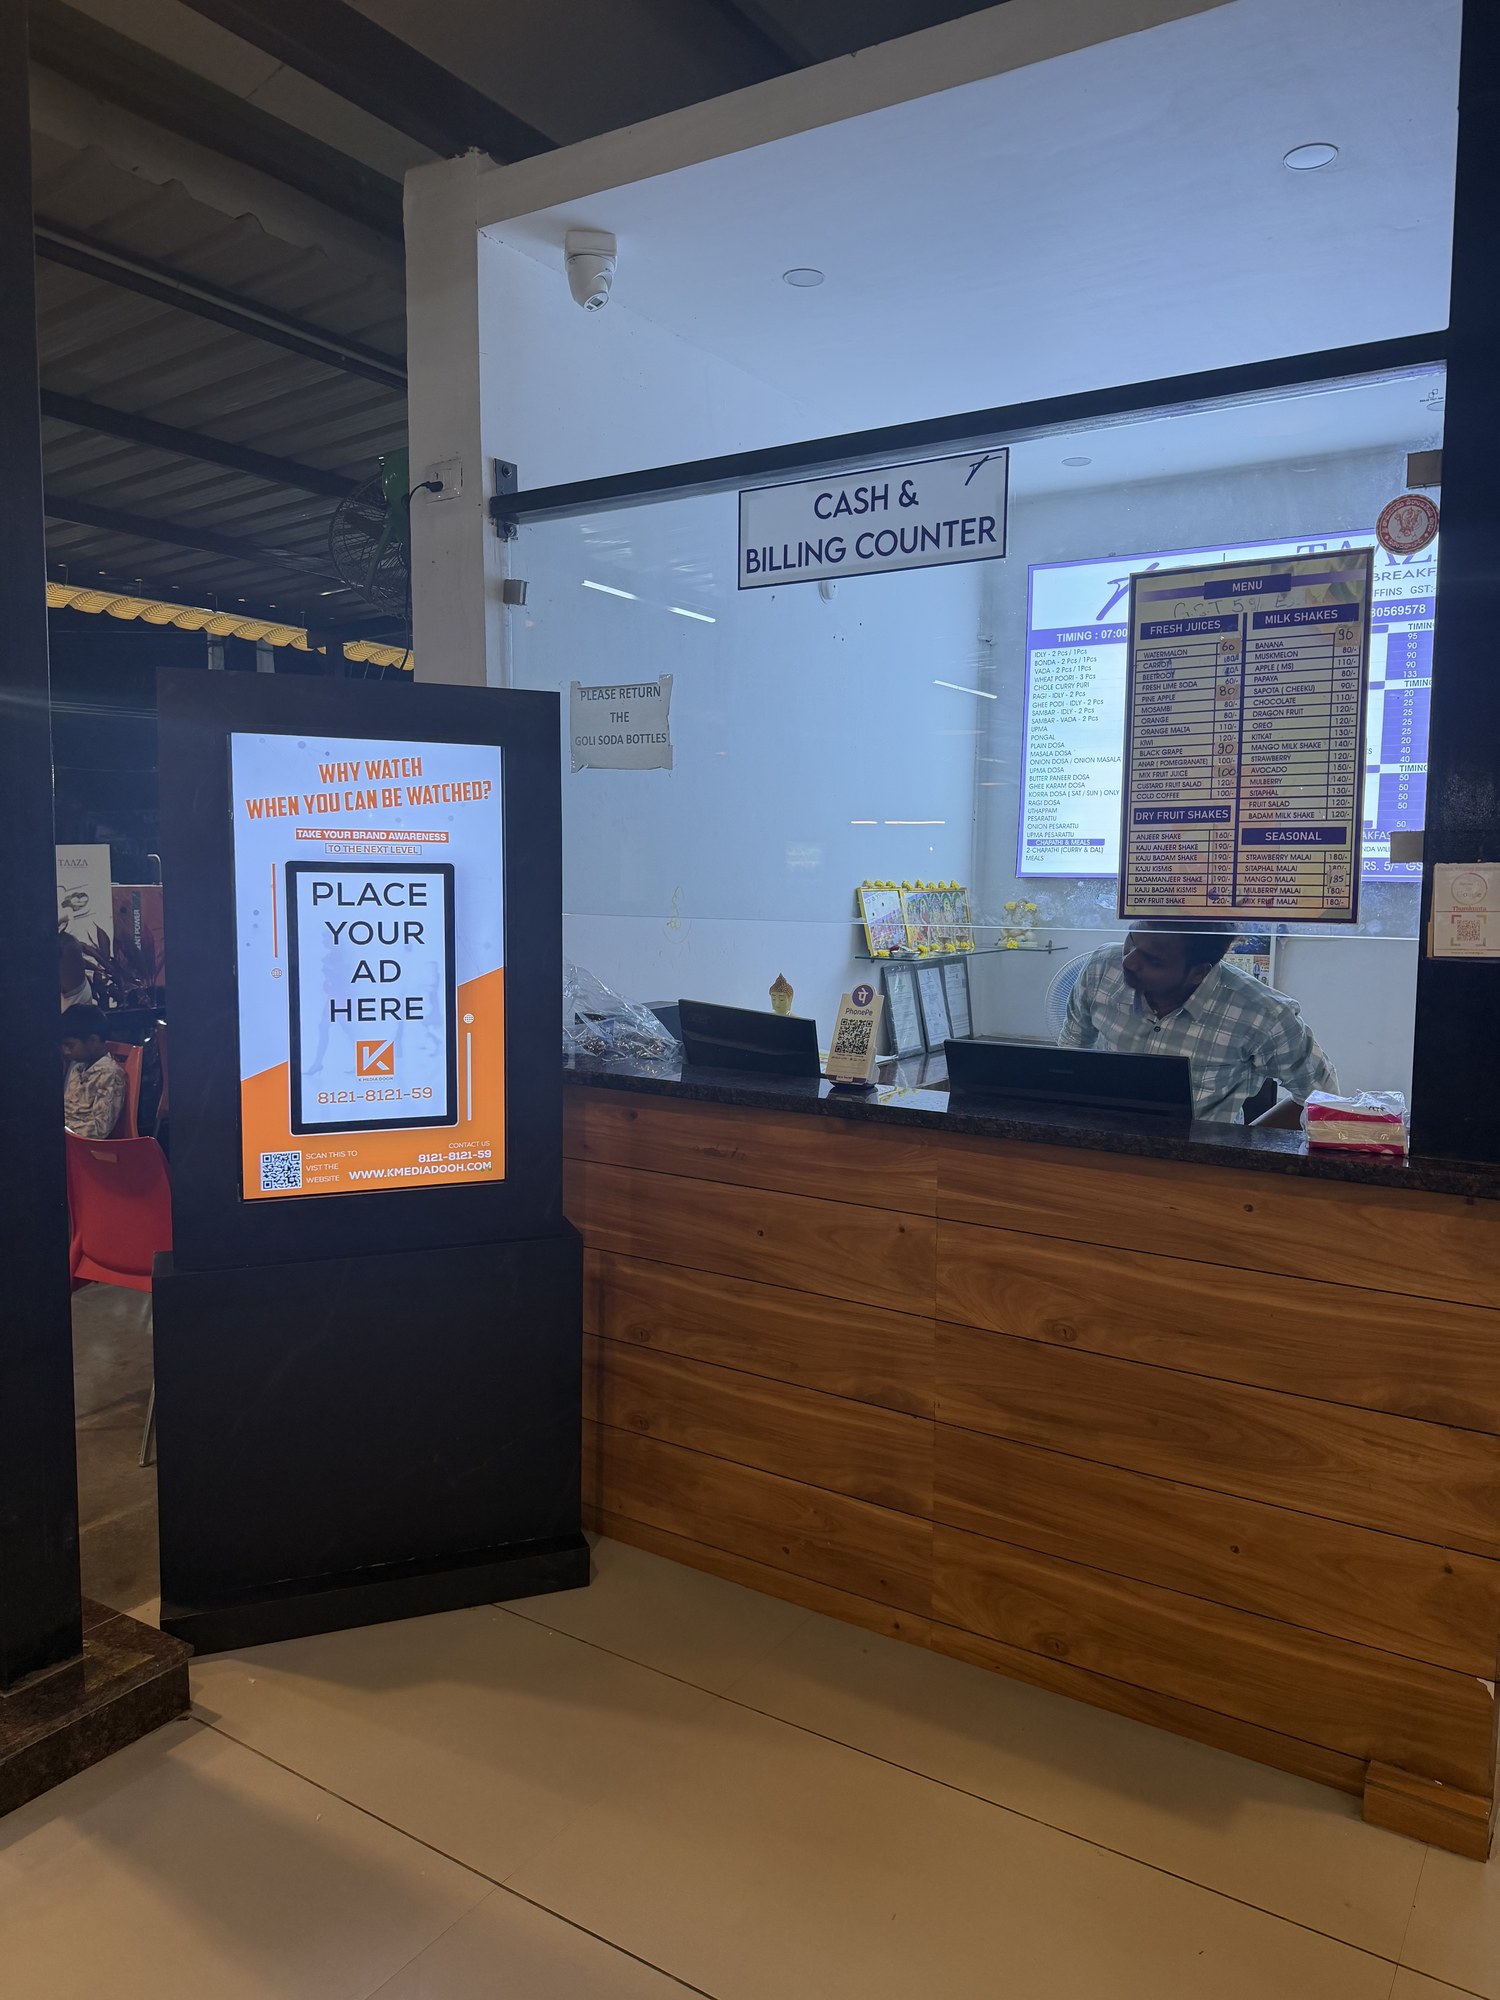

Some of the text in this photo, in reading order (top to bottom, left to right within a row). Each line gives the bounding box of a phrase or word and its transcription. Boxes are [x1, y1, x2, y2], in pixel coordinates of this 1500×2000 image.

[813, 479, 919, 519] CASH &
[746, 515, 997, 574] BILLING COUNTER
[1374, 567, 1436, 582] BREAKF
[1232, 580, 1263, 593] MENU
[1264, 609, 1338, 625] MILK SHAKES
[1150, 620, 1221, 635] FRESH JUICES
[1408, 622, 1434, 630] TIMIN
[1056, 628, 1127, 643] TIMING 07:00
[1255, 641, 1284, 650] BANANA
[1143, 649, 1188, 659] WATERMALON
[1254, 650, 1299, 660] MUSKMELON
[1253, 675, 1279, 683] PAPAYA
[1162, 682, 1177, 690] LIME
[1179, 681, 1198, 689] SODA
[580, 686, 660, 701] PLEASE RETURN
[1220, 686, 1235, 696] 80
[1253, 687, 1280, 695] SAPOTA
[1253, 697, 1296, 706] CHOCOLATE
[1141, 705, 1172, 713] MOSAMBI
[1252, 708, 1284, 717] DRAGON
[610, 711, 630, 723] THE
[1170, 726, 1191, 734] MALTA
[575, 733, 667, 746] GOLI SODA BOTTLES
[1251, 741, 1322, 751] MANGO MILK SHAKE
[318, 756, 423, 784] WHY WATCH
[1251, 766, 1288, 774] AVOCADO
[1136, 782, 1164, 790] CUSTARD
[1182, 780, 1202, 788] SALAD
[245, 780, 492, 820] WHEN YOU CAN BE WATCHED?
[1135, 809, 1229, 821] DRY FRUIT SHAKES
[297, 829, 447, 842] TAKE YOUR BRAND AWARENESS
[1265, 831, 1322, 841] SEASONAL
[328, 844, 418, 855] TO THE NEXT LEVEL
[1363, 861, 1380, 871] RS.
[312, 882, 427, 906] PLACE
[324, 921, 425, 945] YOUR
[350, 960, 402, 983] AD
[330, 997, 424, 1022] HERE
[845, 1007, 873, 1017] PhonePe
[317, 1087, 433, 1105] 8121-8121-59
[448, 1140, 491, 1149] CONTACT US
[305, 1152, 327, 1160] SCAN
[328, 1151, 346, 1159] THIS
[418, 1150, 492, 1163] 8121-8121-59
[305, 1163, 339, 1172] VIST THE
[348, 1161, 492, 1180] WWW.KMEDIADOOH.COM
[305, 1174, 340, 1184] WEBSITE
